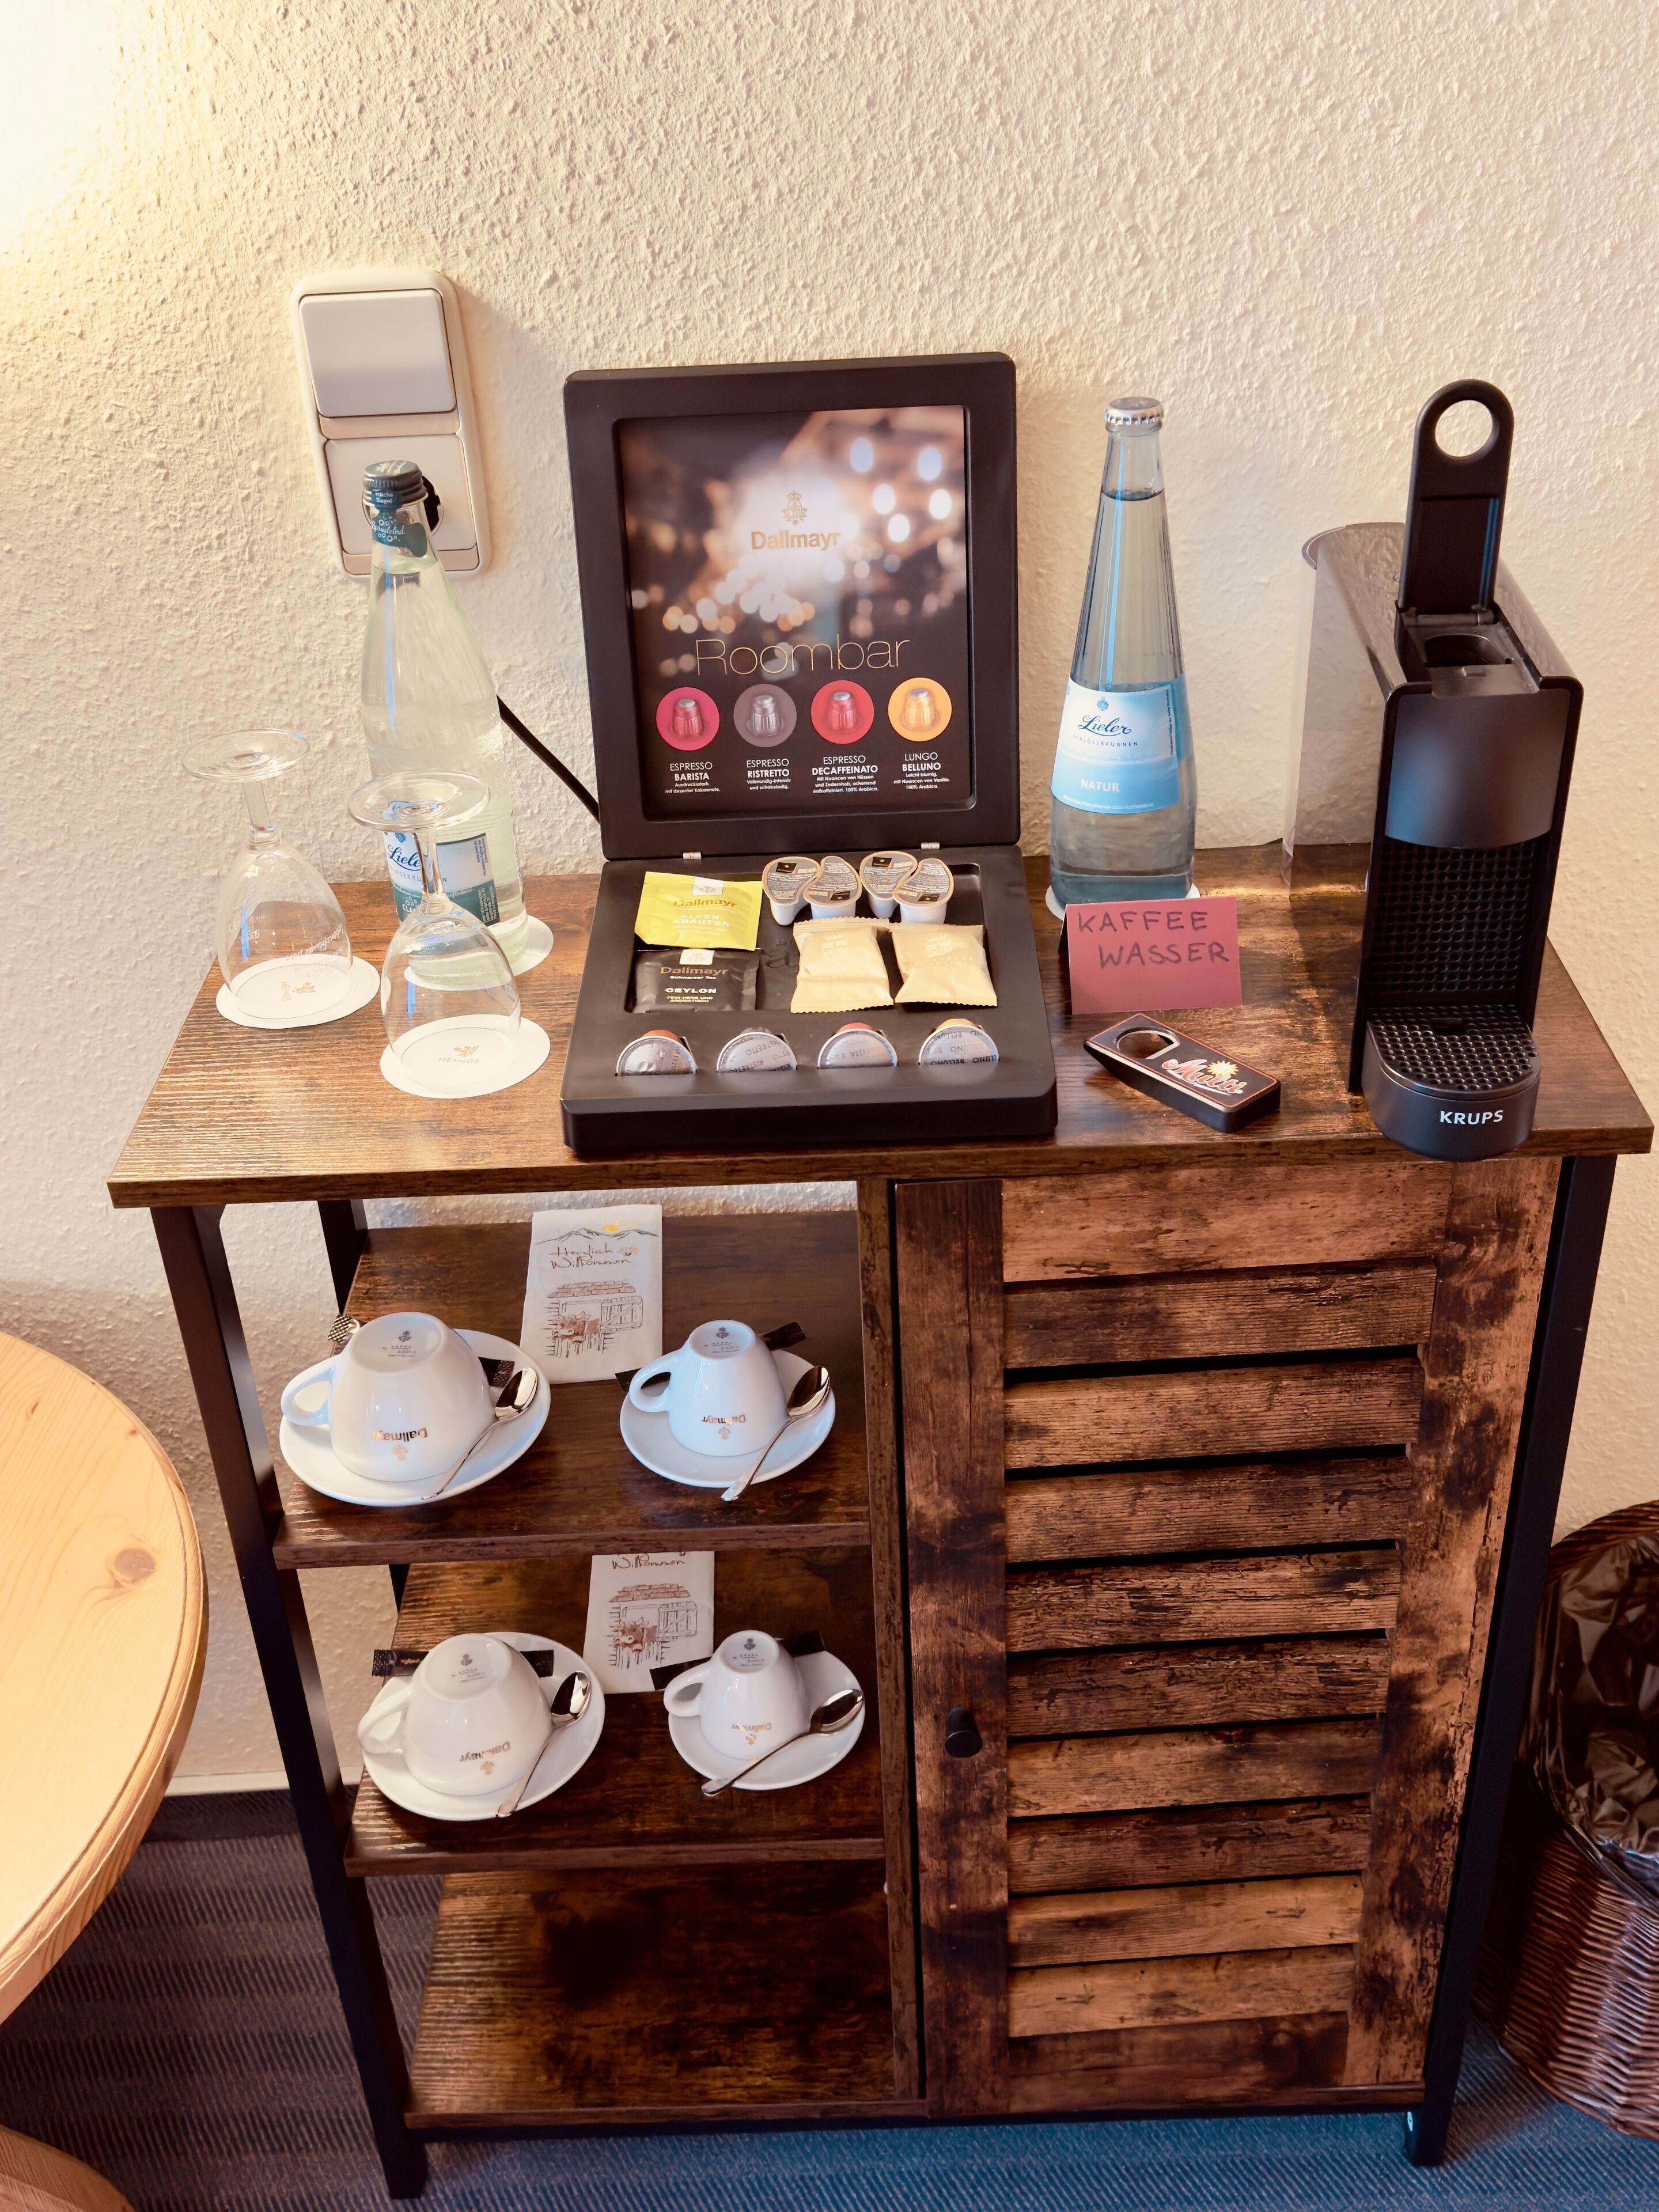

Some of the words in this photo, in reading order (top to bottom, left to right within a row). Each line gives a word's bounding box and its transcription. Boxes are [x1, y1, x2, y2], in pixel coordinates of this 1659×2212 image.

[372, 520, 406, 536] Sprudelnd
[751, 530, 840, 551] Dallmayr
[695, 633, 910, 676] Roombar
[1078, 715, 1132, 737] Lieler
[1073, 734, 1138, 747] SCHLOSSBRUNNEN
[747, 758, 790, 768] ESPRESSO
[823, 755, 866, 765] ESPRESSO
[904, 752, 938, 762] LUNGO
[670, 762, 713, 771] ESPRESSO
[812, 765, 878, 776] DECAFFEINATO
[902, 762, 942, 772] BELLUNO
[674, 772, 710, 782] BARISTA
[747, 769, 790, 778] RISTRETTO
[1081, 778, 1120, 793] NATUR
[387, 844, 421, 871] Liele
[673, 916, 730, 927] KRÄUTER
[1078, 911, 1209, 933] KAFFEE
[1099, 941, 1230, 969] WASSER
[660, 967, 729, 976] Dallmayr
[281, 981, 291, 1002] HEIMBS
[438, 1056, 480, 1065] HEIMBS
[1161, 1058, 1247, 1095] Multi
[1440, 1109, 1504, 1126] KRUPS
[551, 1256, 632, 1270] Willkommen
[702, 1414, 747, 1425] Dallmayr
[370, 1427, 428, 1442] Dallmayr
